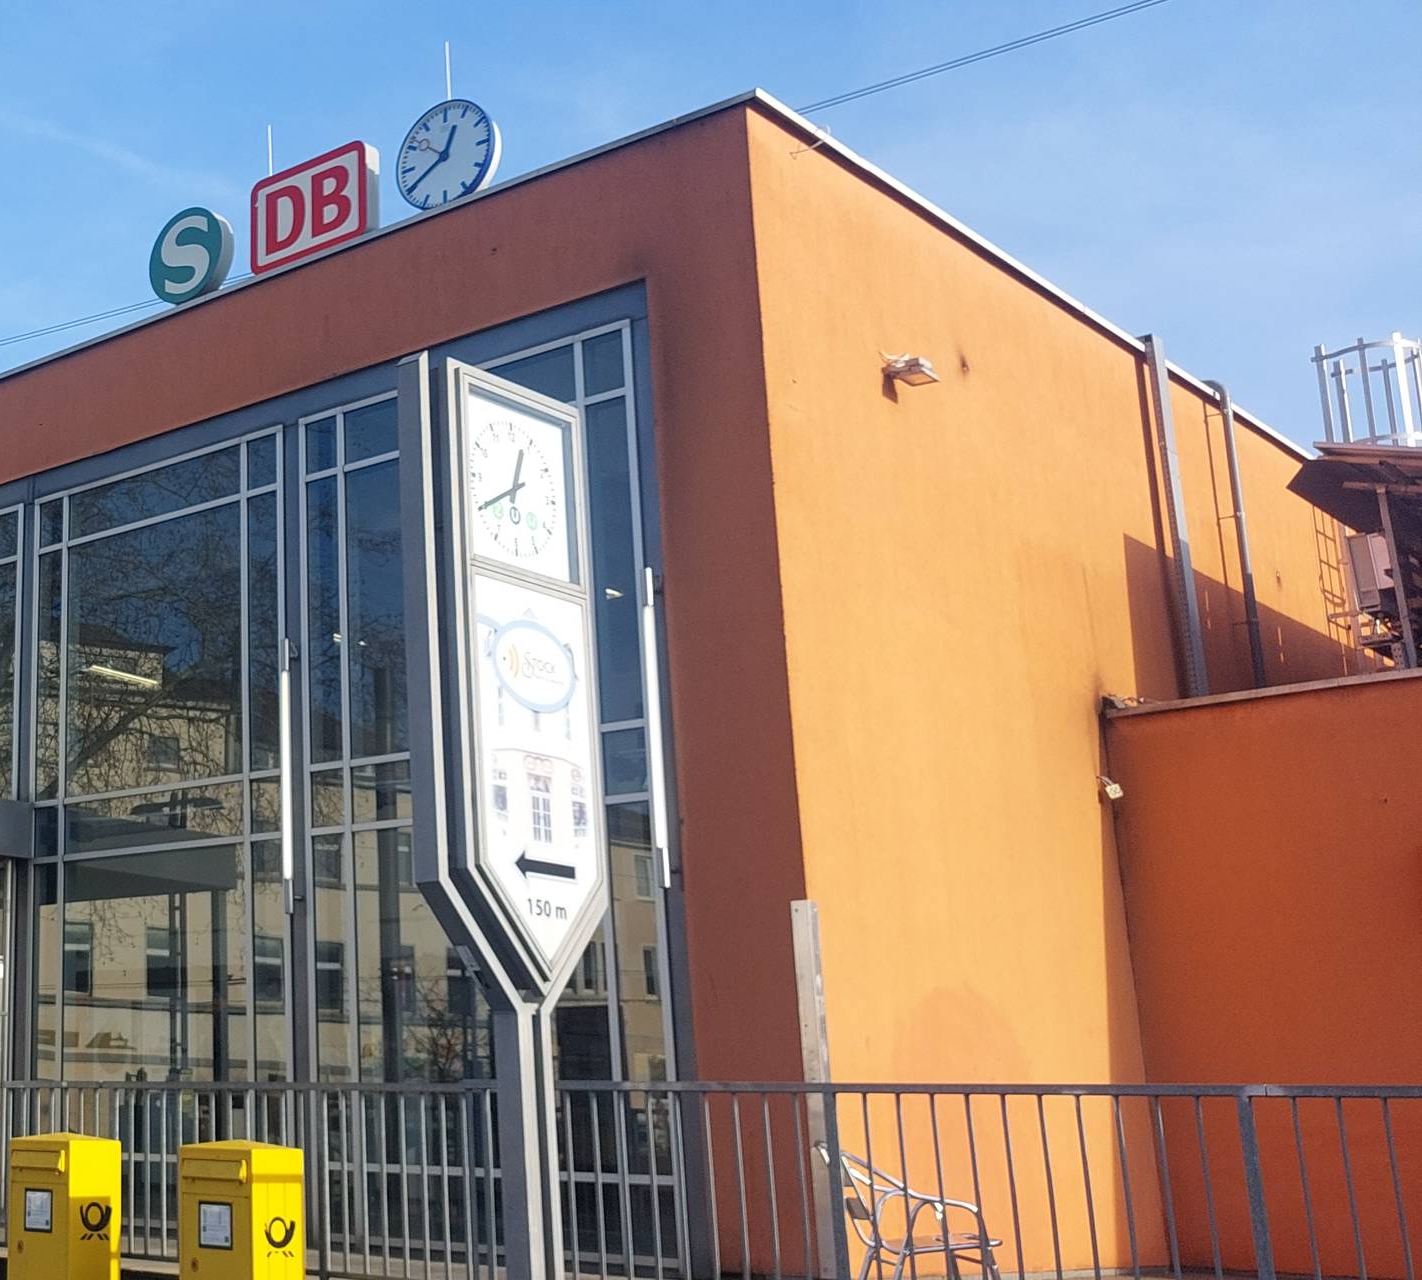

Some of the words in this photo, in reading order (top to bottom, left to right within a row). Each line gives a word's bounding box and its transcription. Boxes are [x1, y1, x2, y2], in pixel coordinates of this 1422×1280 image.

[265, 165, 351, 257] DB
[160, 214, 211, 295] S
[527, 898, 552, 917] 150
[555, 906, 567, 920] m
